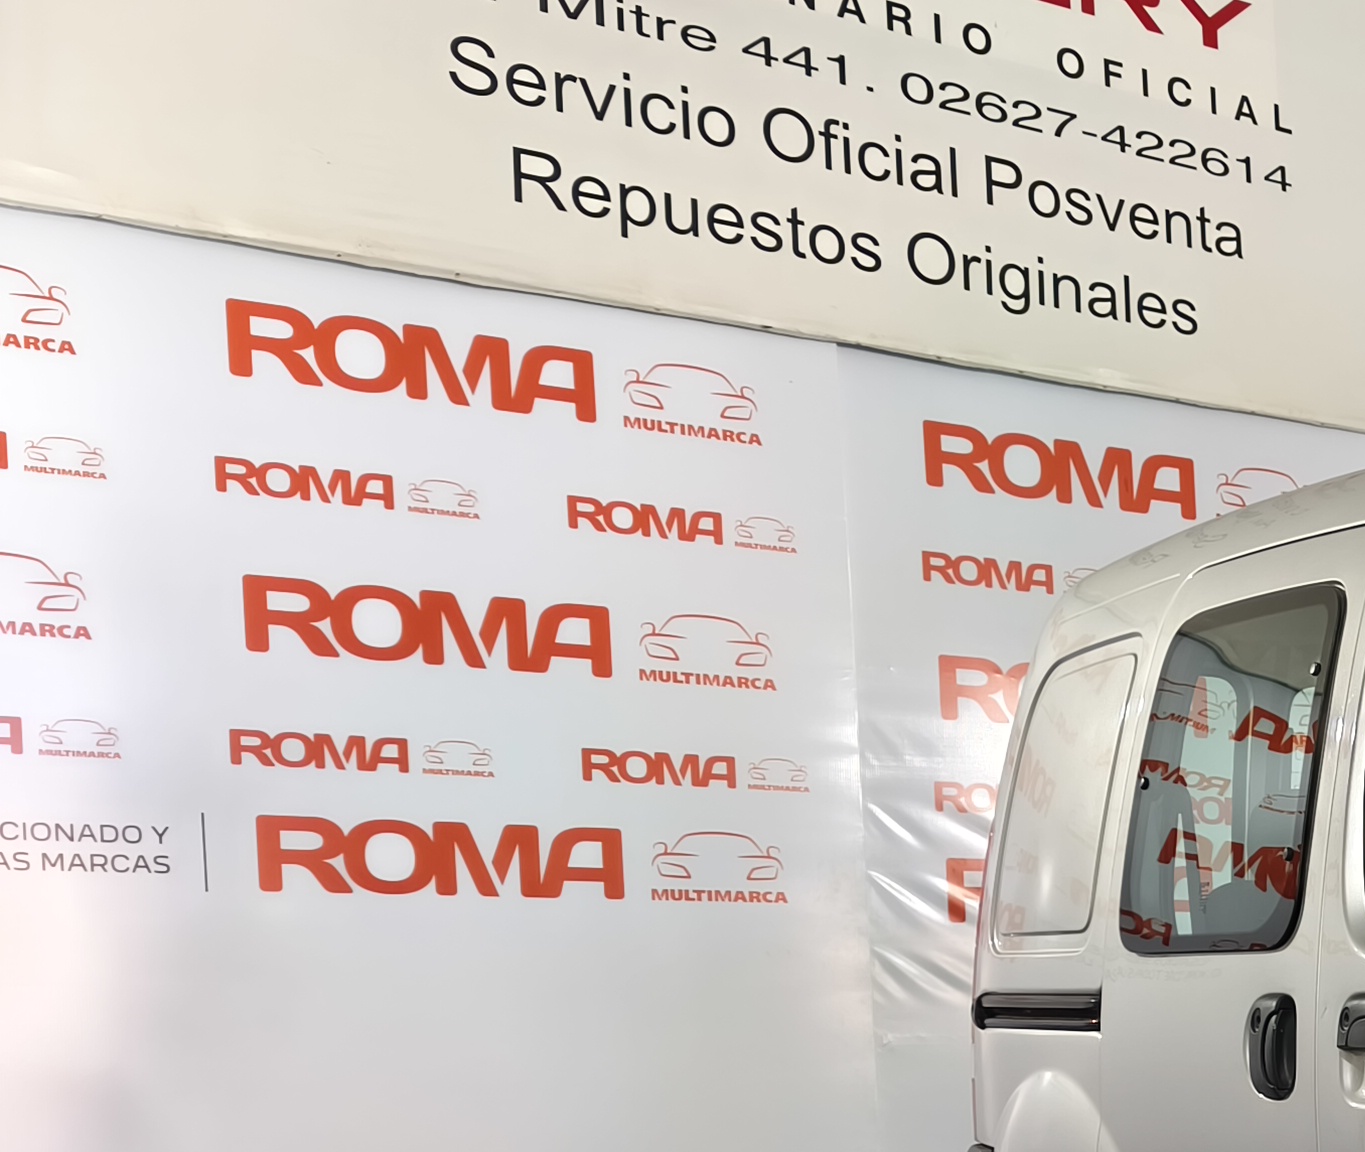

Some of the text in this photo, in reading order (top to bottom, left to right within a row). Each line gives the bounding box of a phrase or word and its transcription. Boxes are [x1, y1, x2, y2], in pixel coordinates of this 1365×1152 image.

[539, 0, 717, 52] Mitre
[900, 72, 1293, 192] 02627-422614
[1056, 47, 1293, 135] OFICIAL
[448, 35, 1243, 259] Servicio Oficial Posventa
[512, 146, 1199, 336] Repuestos Originales
[226, 298, 763, 446] ROMA MULTIMARCA
[23, 464, 107, 480] MULTIMARCA
[214, 455, 481, 521] ROMA MULTIMARCA
[922, 419, 1196, 520] ROMA
[567, 494, 723, 545] ROMA
[922, 550, 1054, 595] ROMA
[242, 573, 778, 692] ROMA MULTIMARCA
[38, 748, 122, 760] MULTIMARCA
[228, 728, 410, 774] ROMA
[581, 747, 737, 789] ROMA
[41, 852, 171, 874] MARCAS
[151, 825, 170, 845] Y
[255, 814, 788, 904] ROMA MULTIMARCA
